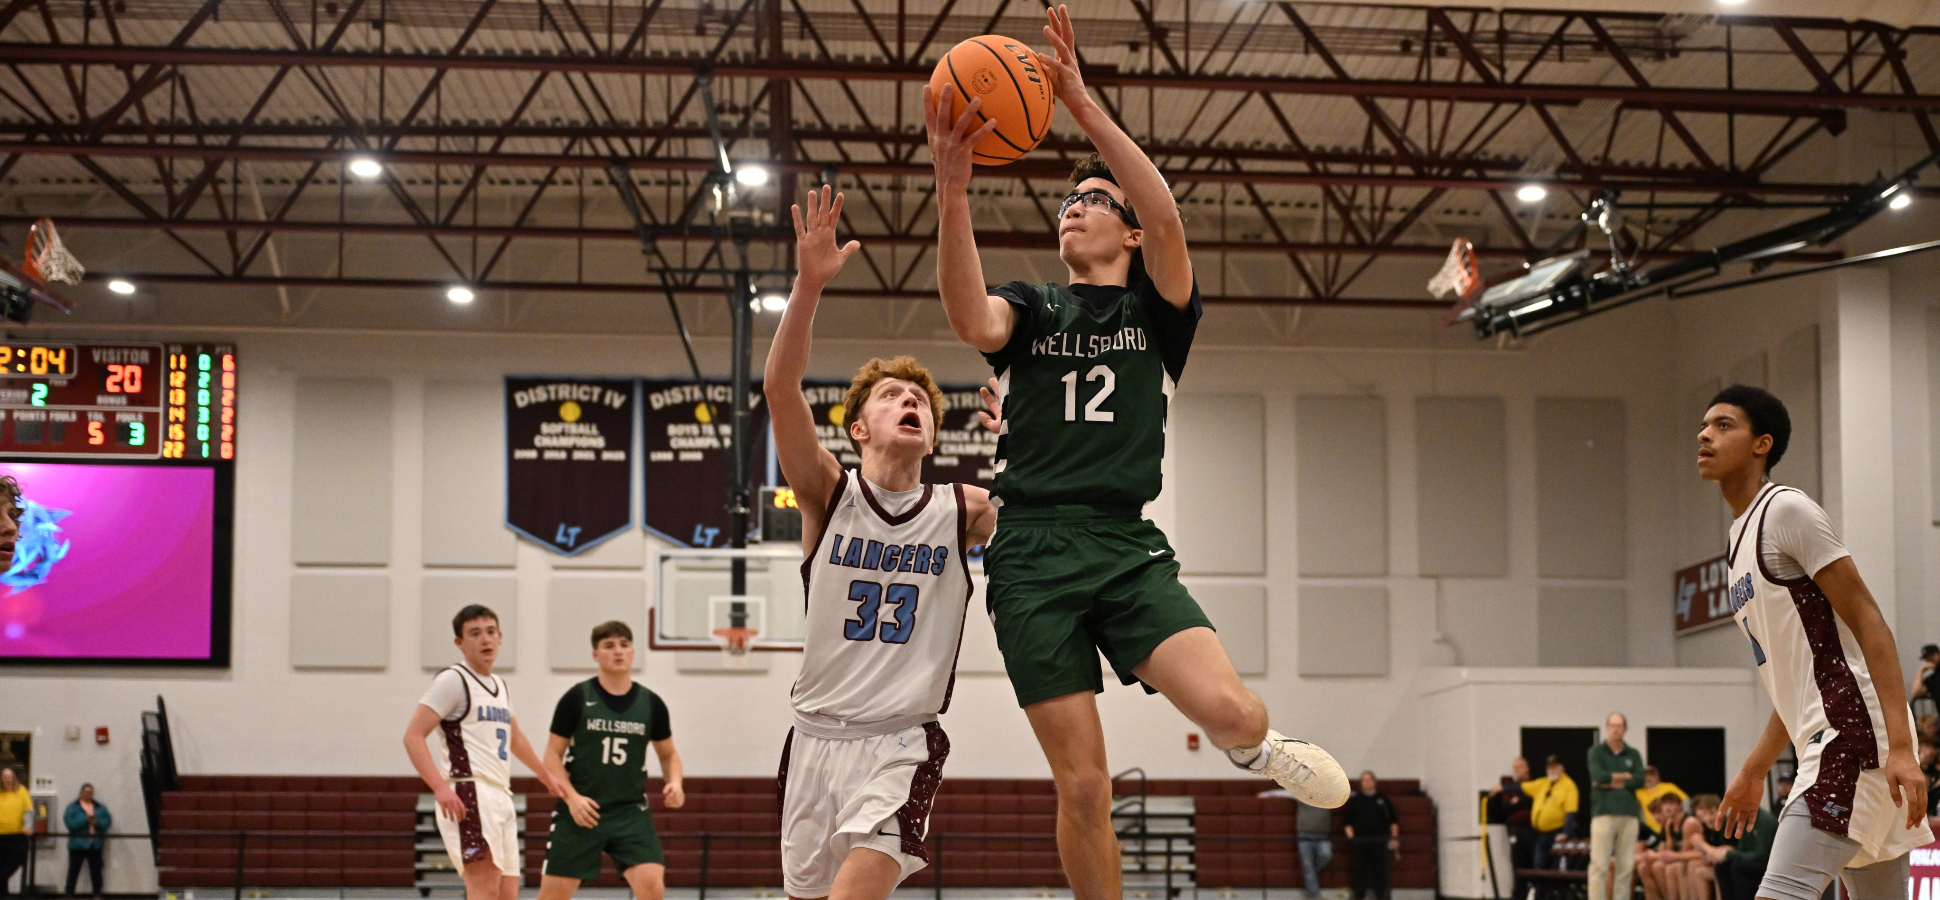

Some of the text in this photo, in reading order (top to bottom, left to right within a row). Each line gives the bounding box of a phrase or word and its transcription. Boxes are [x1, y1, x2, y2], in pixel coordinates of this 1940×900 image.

[1032, 327, 1147, 359] WELLSBORO
[91, 348, 150, 364] VISITOR
[105, 364, 143, 393] 20
[31, 383, 48, 407] 2
[514, 383, 627, 409] DISTRICT IV
[1061, 365, 1116, 422] 12
[13, 410, 47, 422] POINTS
[49, 411, 77, 423] FOULS
[115, 412, 144, 423] FOULS
[540, 422, 599, 436] SOFTBALL
[87, 420, 105, 445] 5
[128, 421, 145, 445] 3
[533, 434, 606, 449] CHAMPIONS
[829, 533, 949, 577] LANCERS
[843, 580, 920, 645] 33
[586, 718, 647, 736] WELLSBORO
[496, 728, 508, 761] 2
[601, 736, 629, 766] 15
